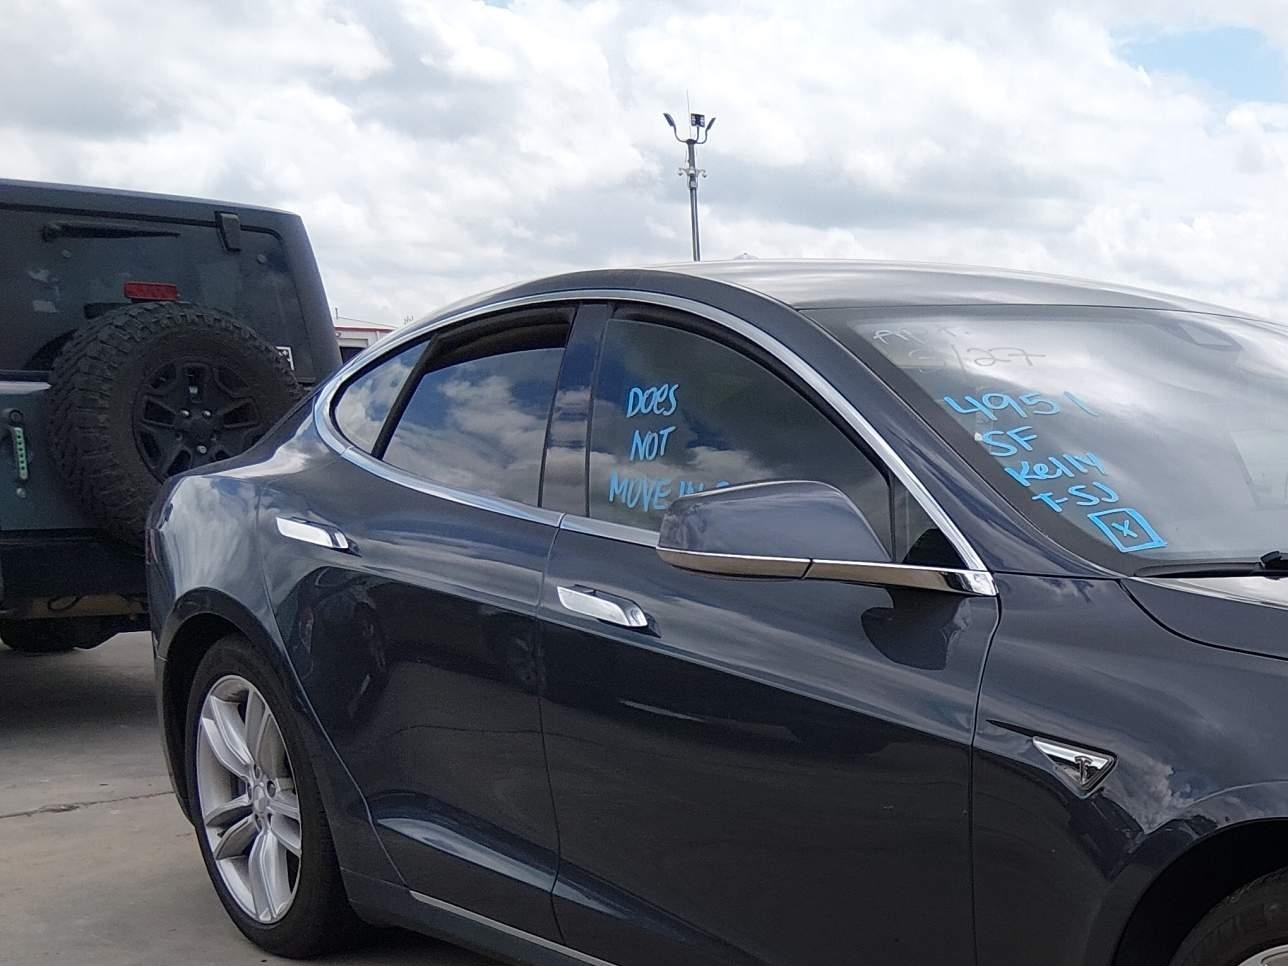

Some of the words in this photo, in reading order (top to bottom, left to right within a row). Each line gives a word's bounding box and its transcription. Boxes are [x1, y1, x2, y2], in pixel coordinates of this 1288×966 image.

[943, 386, 1101, 421] 4951
[629, 425, 677, 461] NOT
[981, 426, 1038, 457] SF
[608, 464, 672, 513] MOVE
